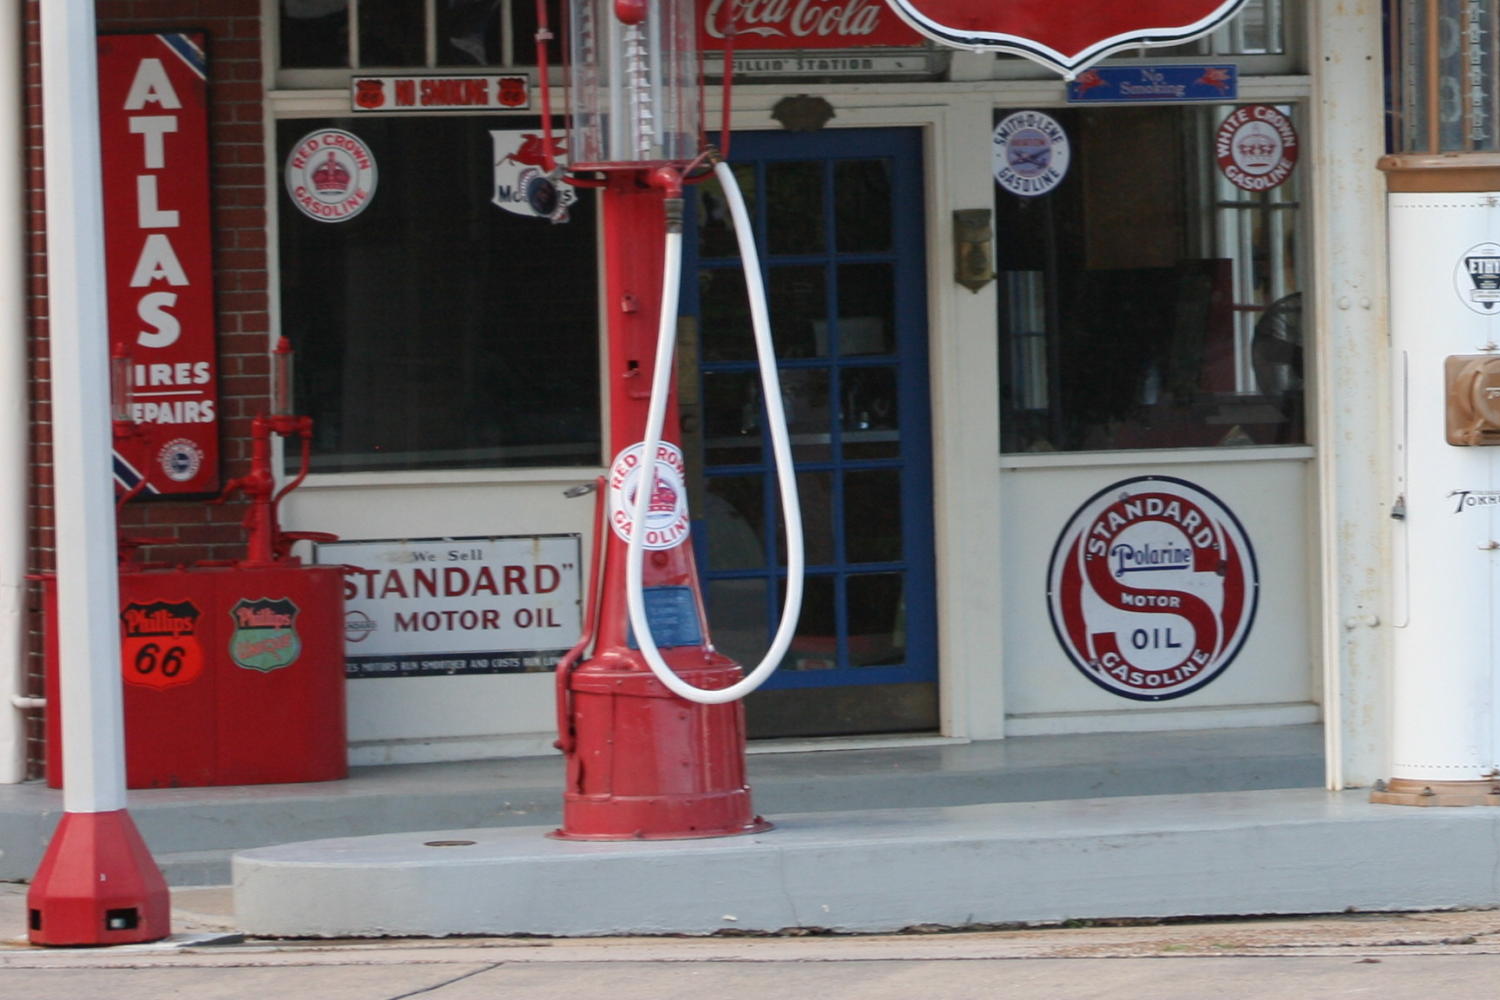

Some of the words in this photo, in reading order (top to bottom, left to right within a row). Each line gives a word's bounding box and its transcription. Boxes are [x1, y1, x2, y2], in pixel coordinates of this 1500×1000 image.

[1120, 81, 1186, 97] Smoking
[1141, 69, 1164, 81] No
[1216, 110, 1249, 157] WHITE
[1253, 106, 1297, 148] CROWN
[292, 140, 319, 169] RED
[322, 135, 370, 169] CROWN
[998, 166, 1060, 192] GASOLINE
[1225, 160, 1295, 190] GASOLINE
[123, 58, 189, 348] ATLAS
[295, 186, 367, 216] GASOLINE
[611, 454, 638, 490] RED
[613, 509, 690, 545] GAOLIN
[412, 551, 436, 562] We
[448, 549, 483, 561] Sell
[1111, 542, 1191, 578] Polarine
[1121, 592, 1181, 608] MOTOR
[125, 608, 193, 637] Phillips
[395, 610, 500, 632] MOTOR
[514, 608, 561, 628] OIL
[1132, 628, 1181, 649] OIL
[135, 643, 185, 677] 66
[470, 658, 489, 669] AND
[492, 657, 519, 668] COSTS
[1102, 649, 1209, 686] GASOLINE
